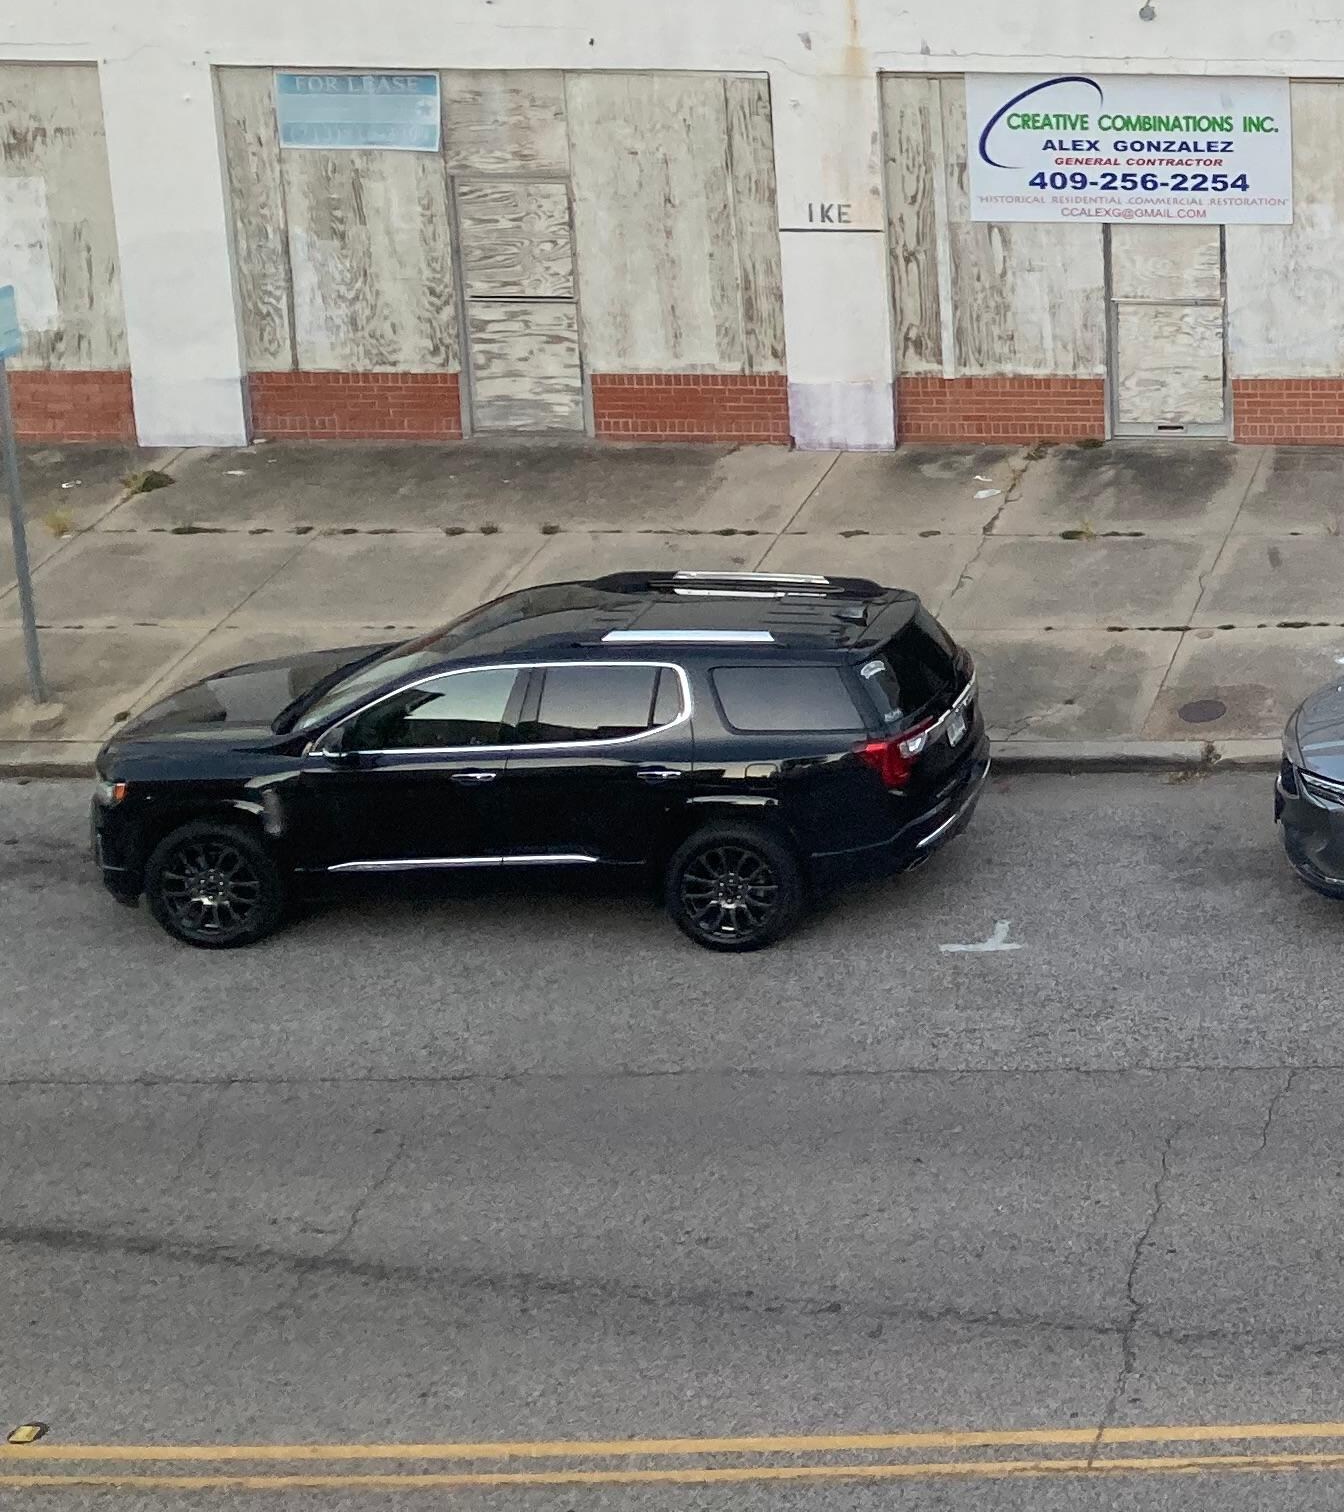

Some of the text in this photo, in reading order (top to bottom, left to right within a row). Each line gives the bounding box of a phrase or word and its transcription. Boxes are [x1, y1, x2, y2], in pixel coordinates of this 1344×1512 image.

[294, 75, 417, 93] FOR LEASE
[1006, 112, 1279, 133] CREATIVE COMBINATIONS INC.
[1041, 139, 1235, 153] ALEX GONZALEZ
[1054, 157, 1224, 167] GENERAL CONTRACTOR
[1028, 171, 1250, 192] 409-256-2254
[807, 202, 852, 224] IKE
